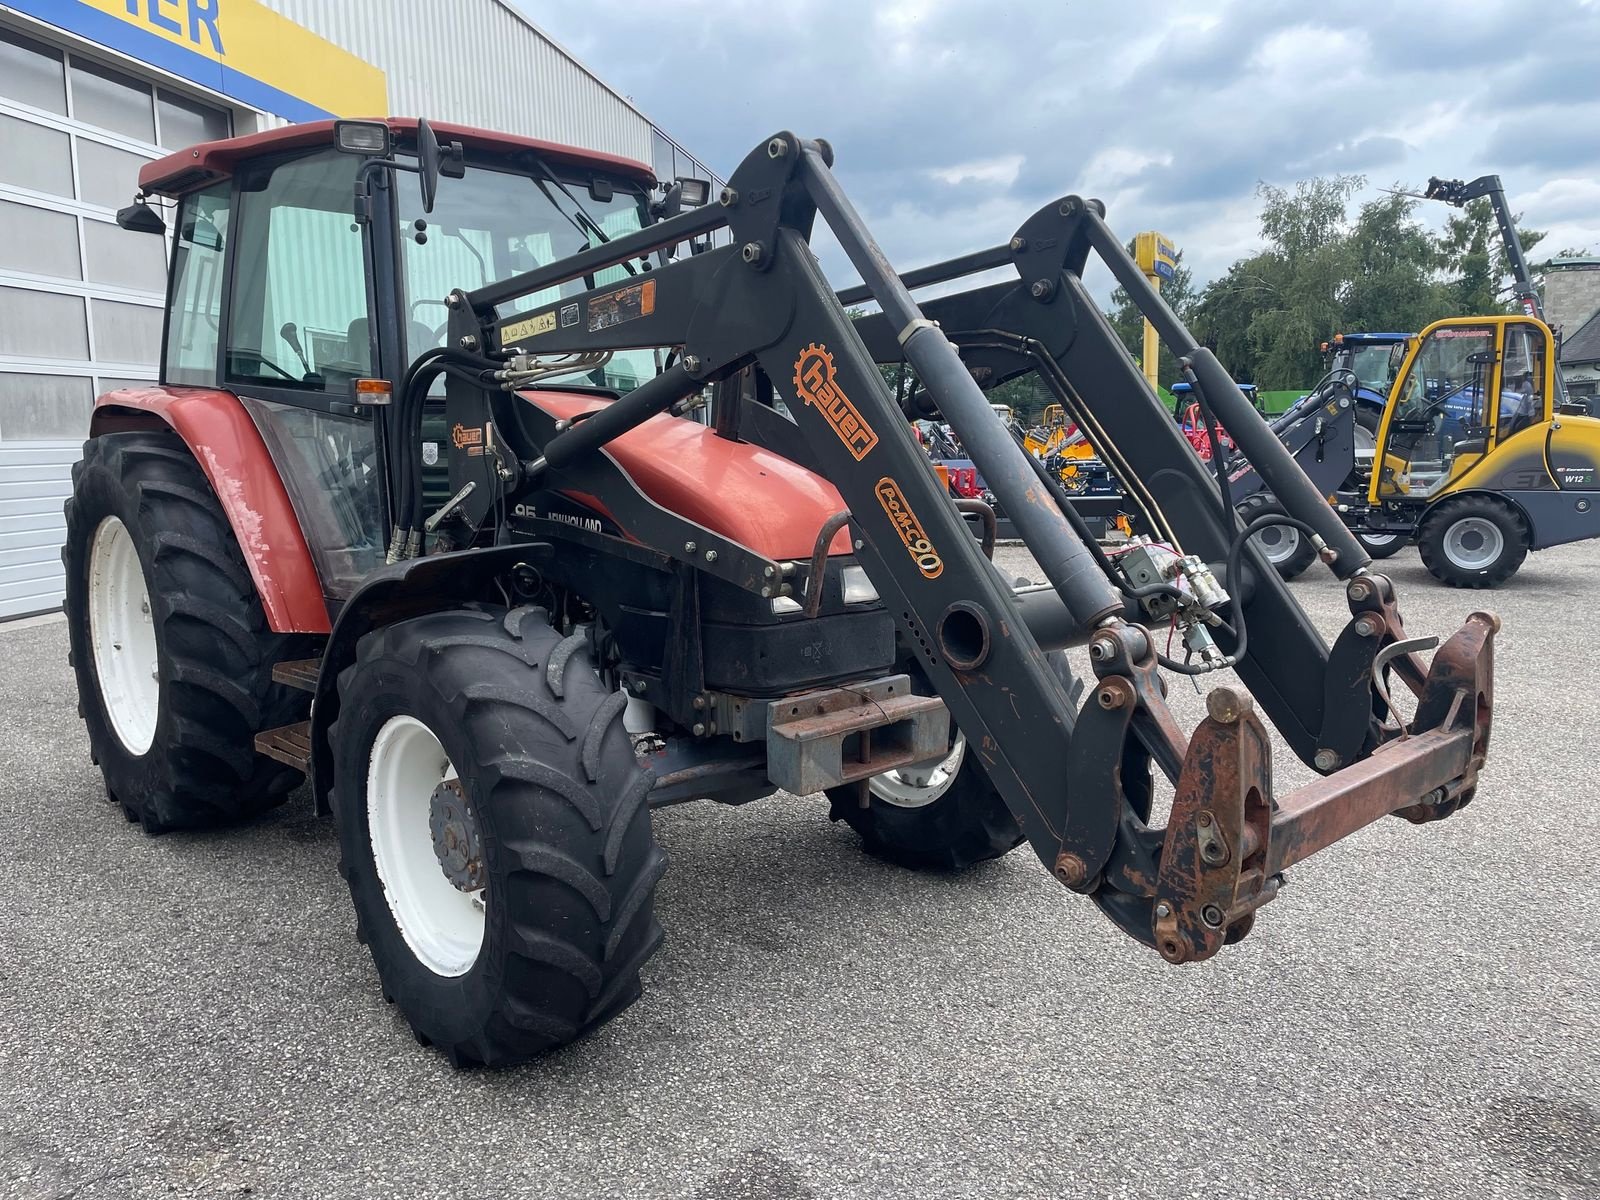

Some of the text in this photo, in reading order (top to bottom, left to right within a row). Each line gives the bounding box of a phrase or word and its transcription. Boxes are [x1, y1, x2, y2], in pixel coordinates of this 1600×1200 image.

[126, 0, 225, 56] ER
[802, 359, 871, 448] hauer
[1565, 475, 1583, 483] W12
